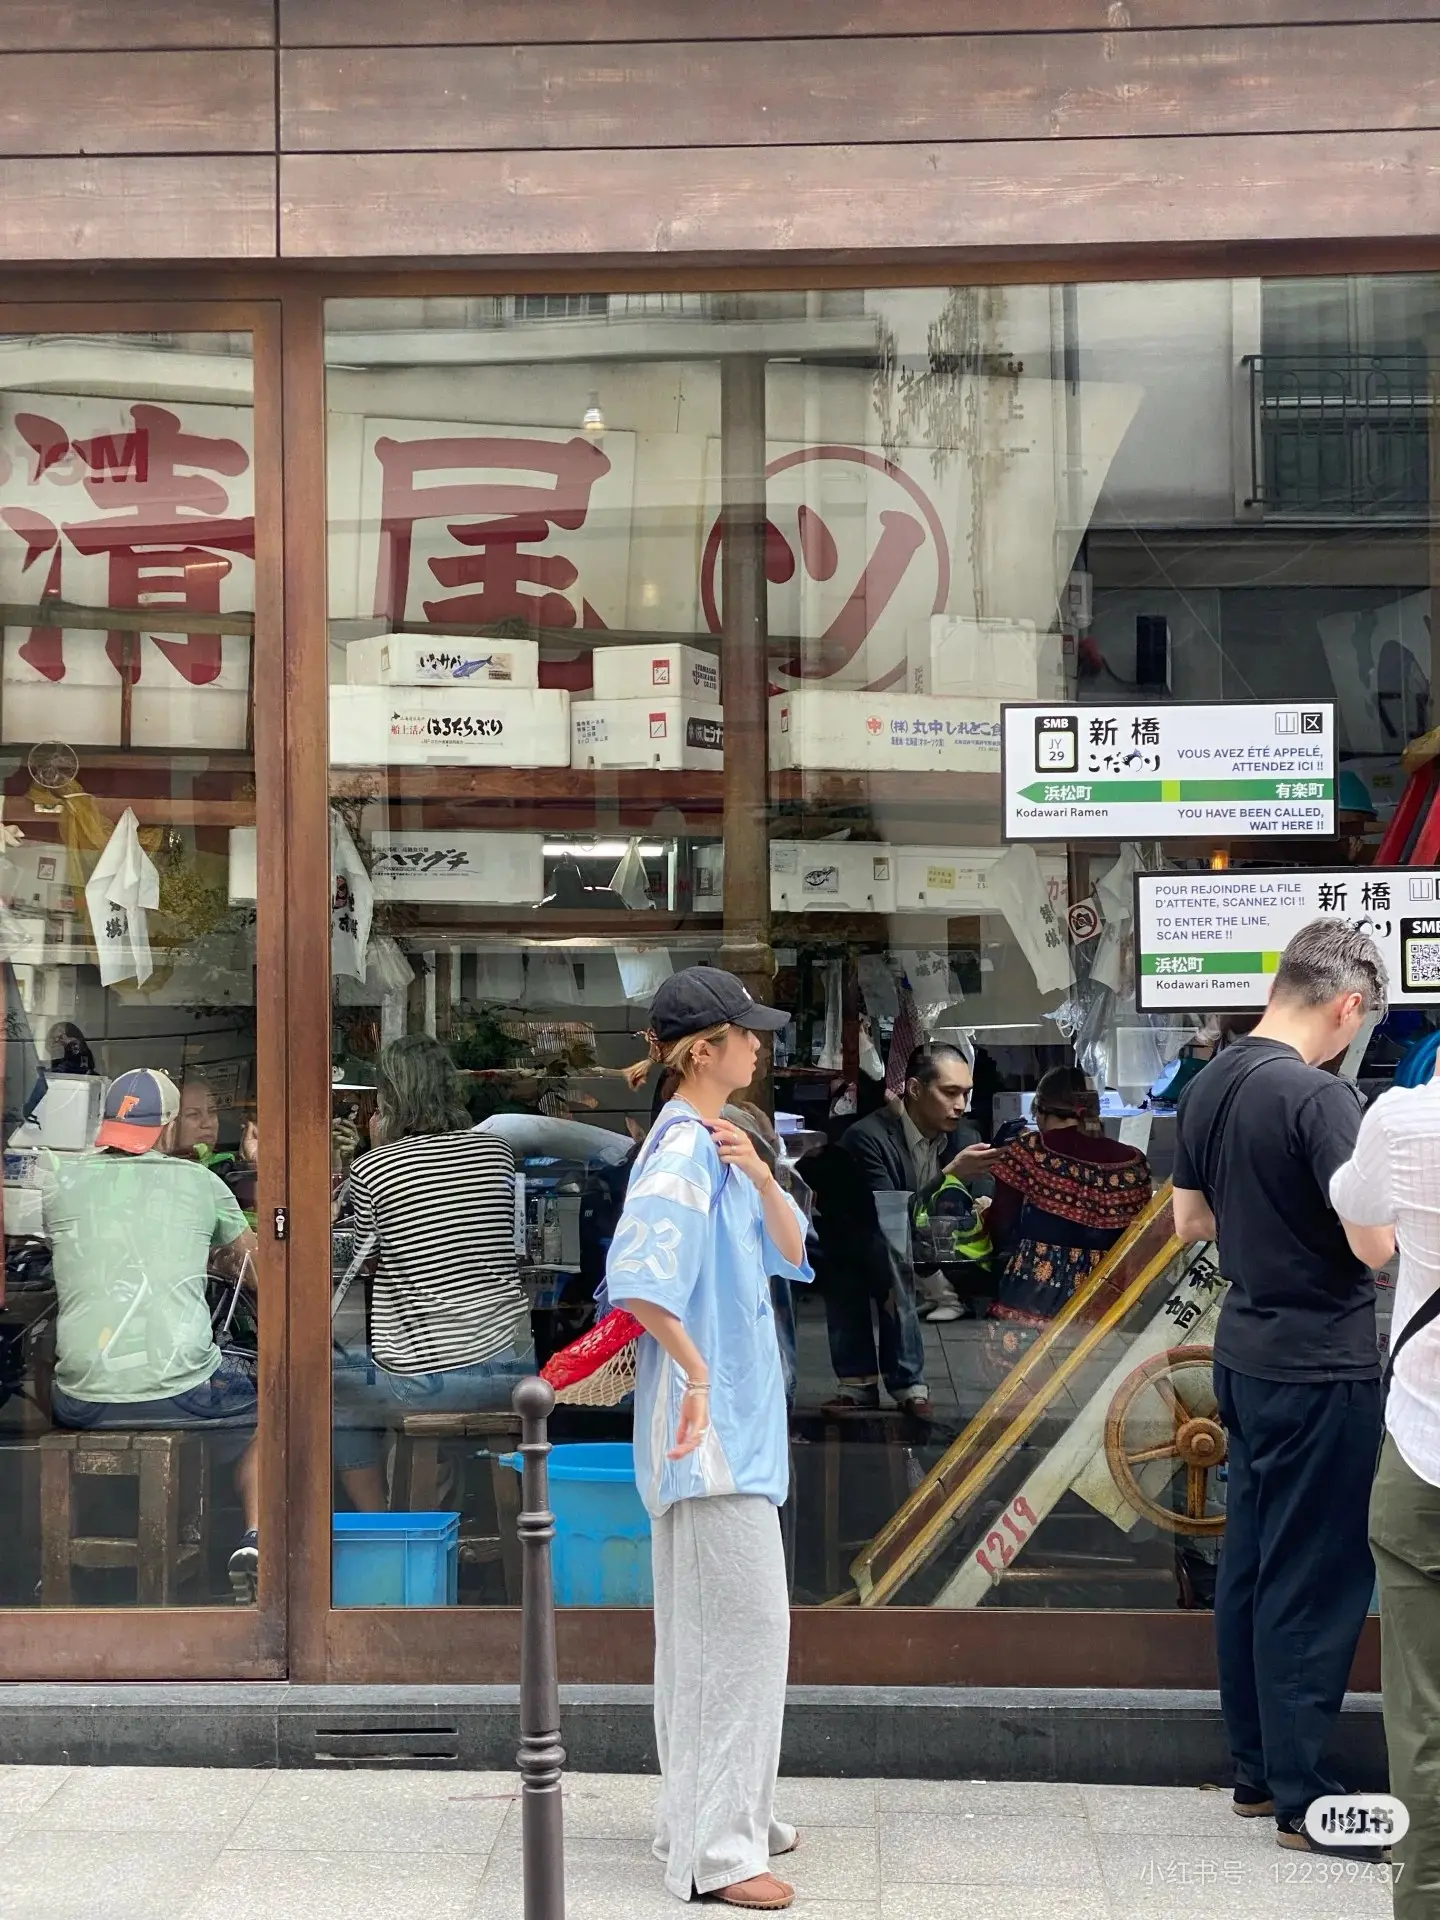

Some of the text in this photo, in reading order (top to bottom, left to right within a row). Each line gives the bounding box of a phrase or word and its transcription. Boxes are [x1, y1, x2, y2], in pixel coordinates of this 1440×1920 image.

[1043, 718, 1069, 729] SMB
[1089, 717, 1160, 746] 新橋
[1049, 739, 1062, 749] JY
[1049, 751, 1065, 761] 29
[1177, 745, 1324, 759] VOUS AVEZ ÉTÉ APPELÉ,
[1232, 761, 1324, 771] ATTENDEZ ICI !!
[1044, 785, 1092, 801] 浜松町
[1275, 783, 1324, 799] 有楽町
[1016, 808, 1108, 817] Kodawari Ramen
[1178, 808, 1324, 819] YOU HAVE BEEN CALLED,
[1250, 821, 1324, 831] WAIT HERE !!
[1156, 883, 1301, 895] POUR REJOINDRE LA FILE
[1318, 882, 1391, 911] 新橋
[1156, 896, 1305, 909] D'ATTENTE, SCANNEZ ICI !!
[1156, 916, 1270, 927] TO ENTER THE LINE,
[1156, 930, 1233, 941] SCAN HERE !!
[1155, 957, 1204, 973] 浜松町
[1156, 980, 1250, 990] Kodawari Ramen
[612, 1215, 682, 1280] 23
[976, 1496, 1038, 1574] 1219
